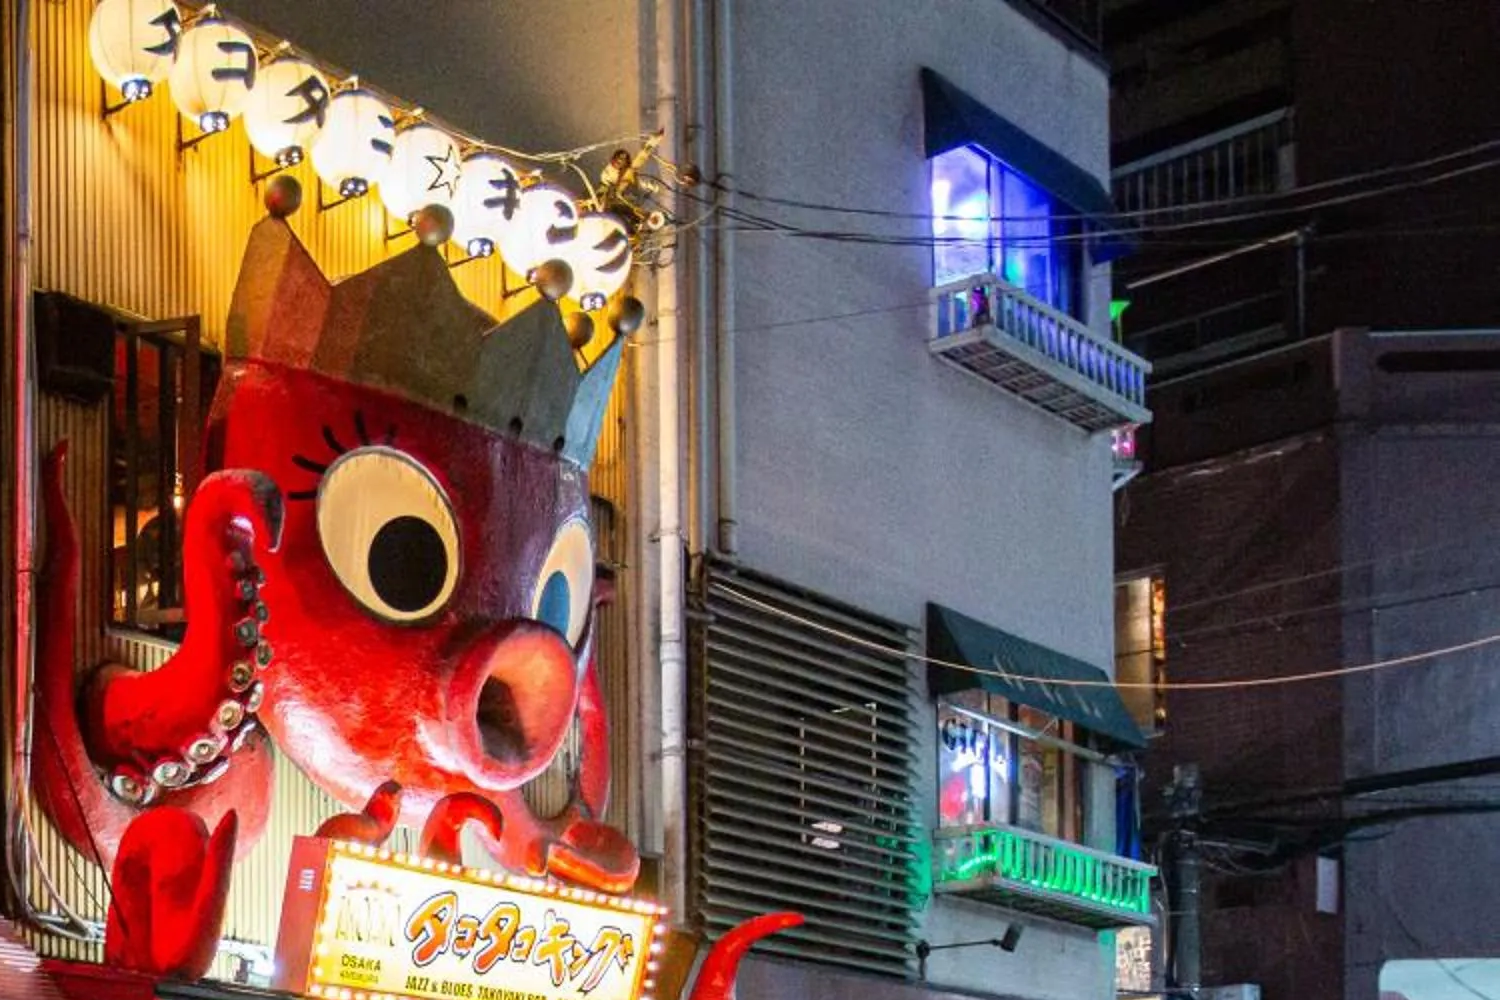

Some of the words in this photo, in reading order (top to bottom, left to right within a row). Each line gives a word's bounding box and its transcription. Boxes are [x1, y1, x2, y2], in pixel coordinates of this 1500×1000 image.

[404, 890, 634, 996] タコタコキング
[341, 953, 381, 971] OSAKA
[405, 976, 430, 992] JAZZ
[440, 981, 474, 998] BLUES
